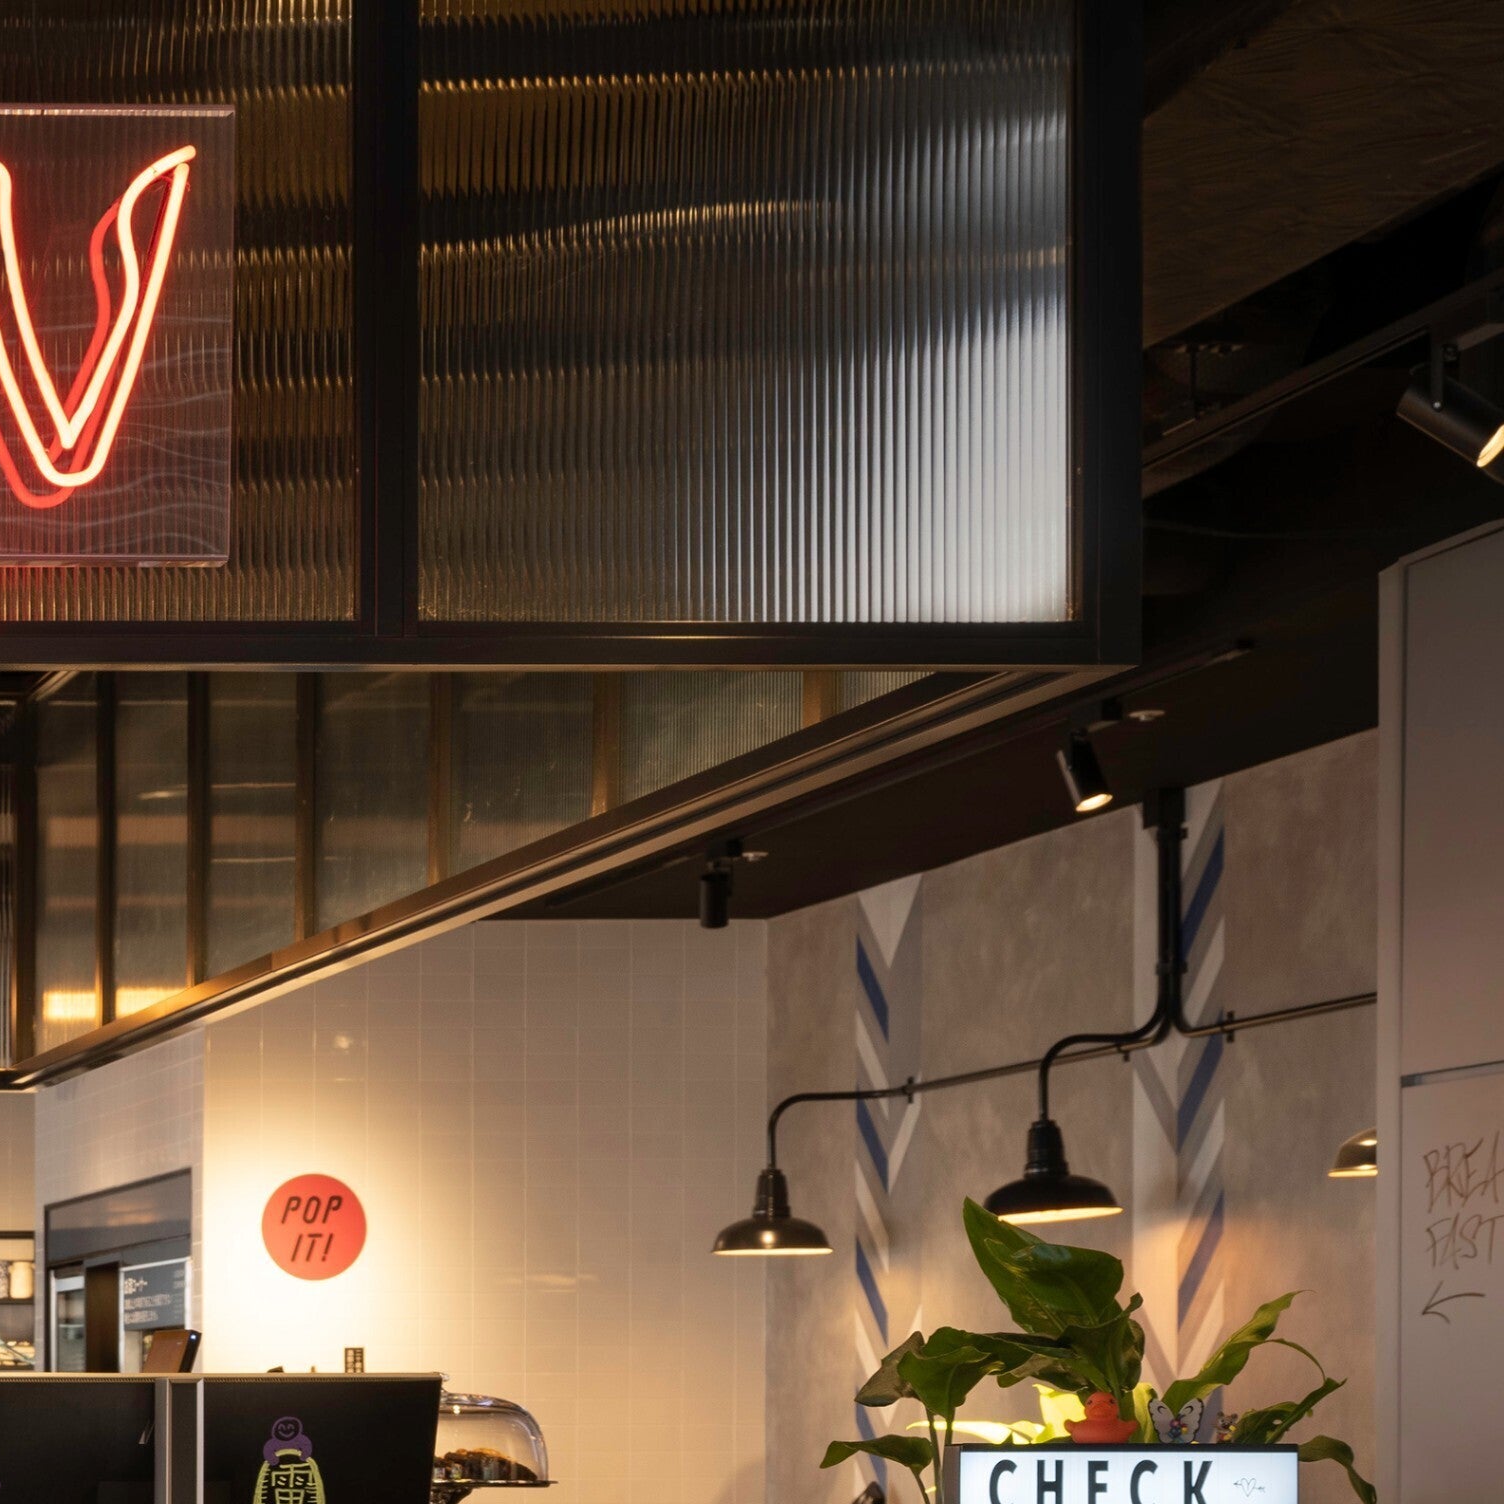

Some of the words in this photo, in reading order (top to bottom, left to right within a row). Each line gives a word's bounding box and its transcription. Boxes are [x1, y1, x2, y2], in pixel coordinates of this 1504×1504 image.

[280, 1194, 344, 1226] POP
[290, 1230, 336, 1264] IT!
[1424, 1211, 1504, 1270] FAST
